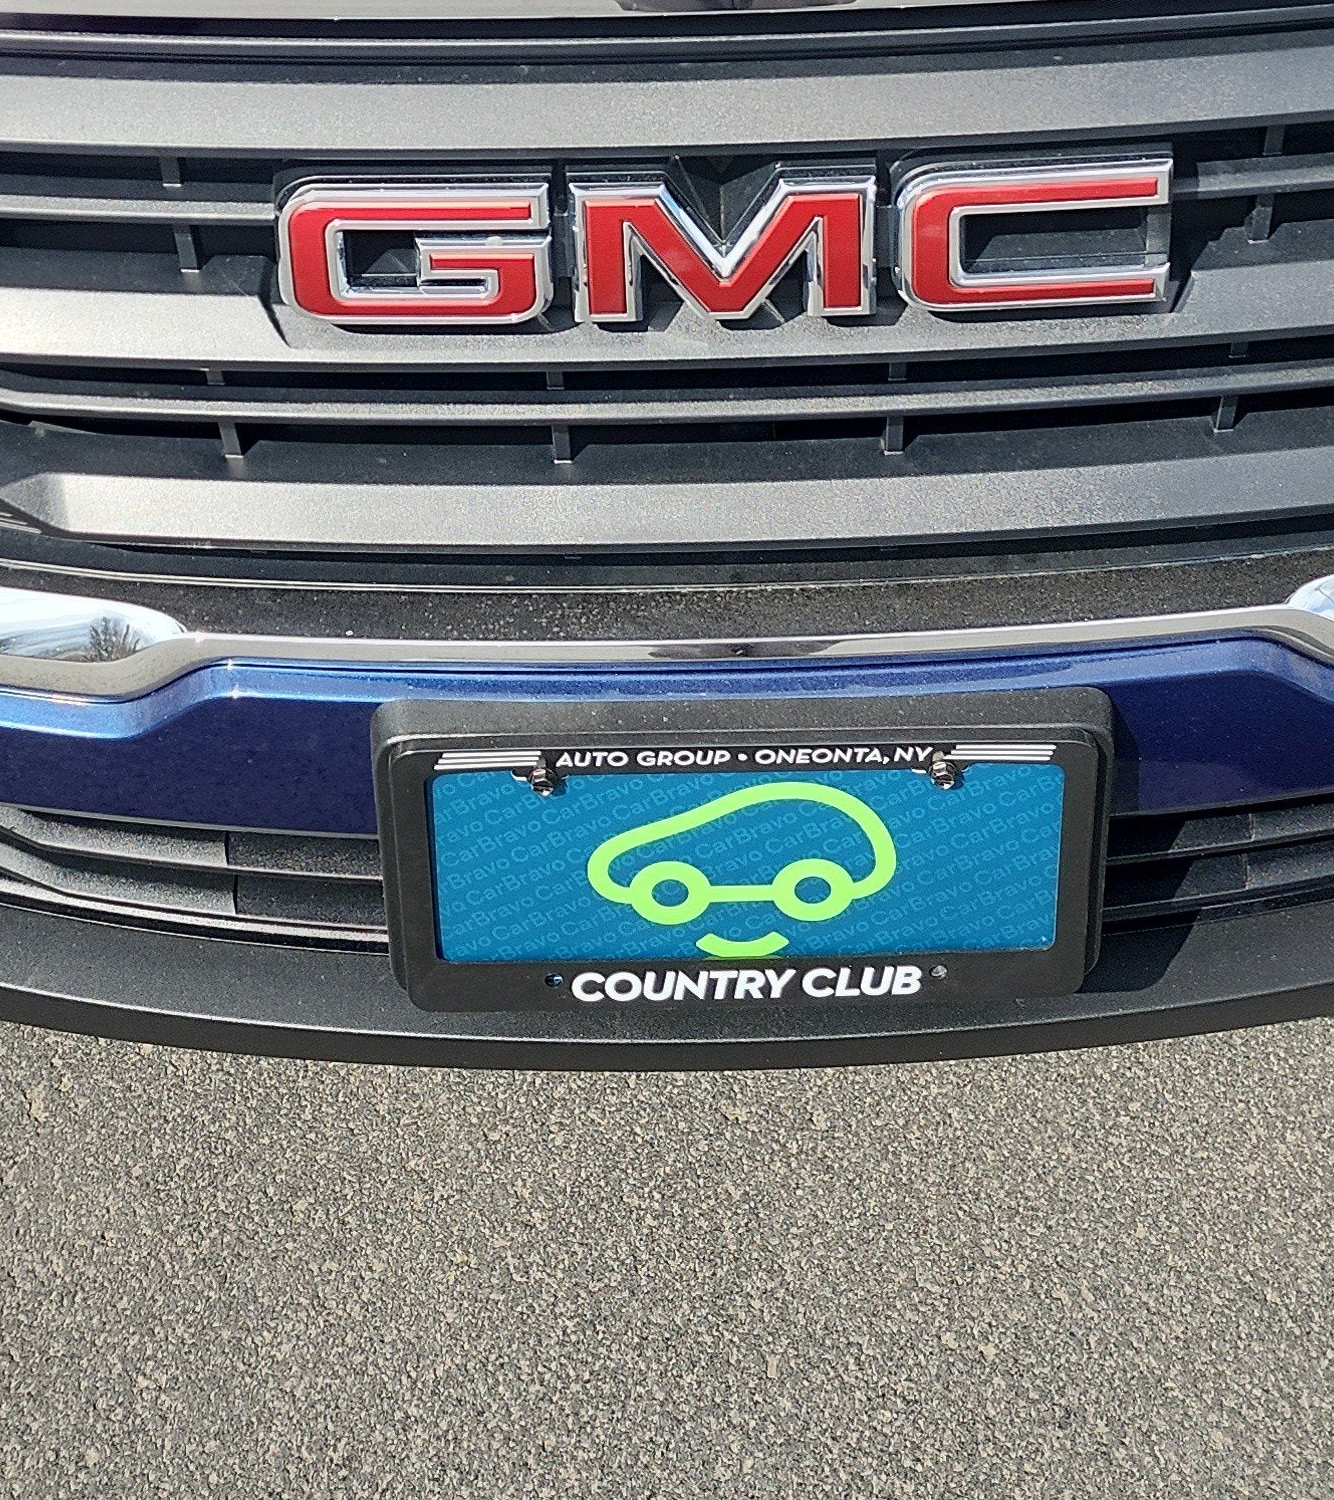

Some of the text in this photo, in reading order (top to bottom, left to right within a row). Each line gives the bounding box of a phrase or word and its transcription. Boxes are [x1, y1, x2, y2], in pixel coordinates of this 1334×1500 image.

[278, 156, 1173, 325] GMC
[556, 751, 628, 768] AUTO
[636, 750, 731, 767] GROUP
[927, 766, 1031, 810] CarBravo
[441, 820, 541, 867] CarBravo
[542, 779, 644, 824] CarBravo
[510, 816, 611, 863] CarBravo
[612, 773, 714, 820] CarBravo
[695, 812, 797, 858] CarBravo
[894, 803, 997, 848] CarBravo
[951, 803, 1055, 848] CarBravo
[466, 860, 566, 905] CarBravo
[917, 840, 1019, 885] CarBravo
[492, 896, 591, 940] CarBravo
[871, 882, 973, 925] CarBravo
[940, 876, 1042, 920] CarBravo
[571, 965, 923, 1002] COUNTRY CLUB
